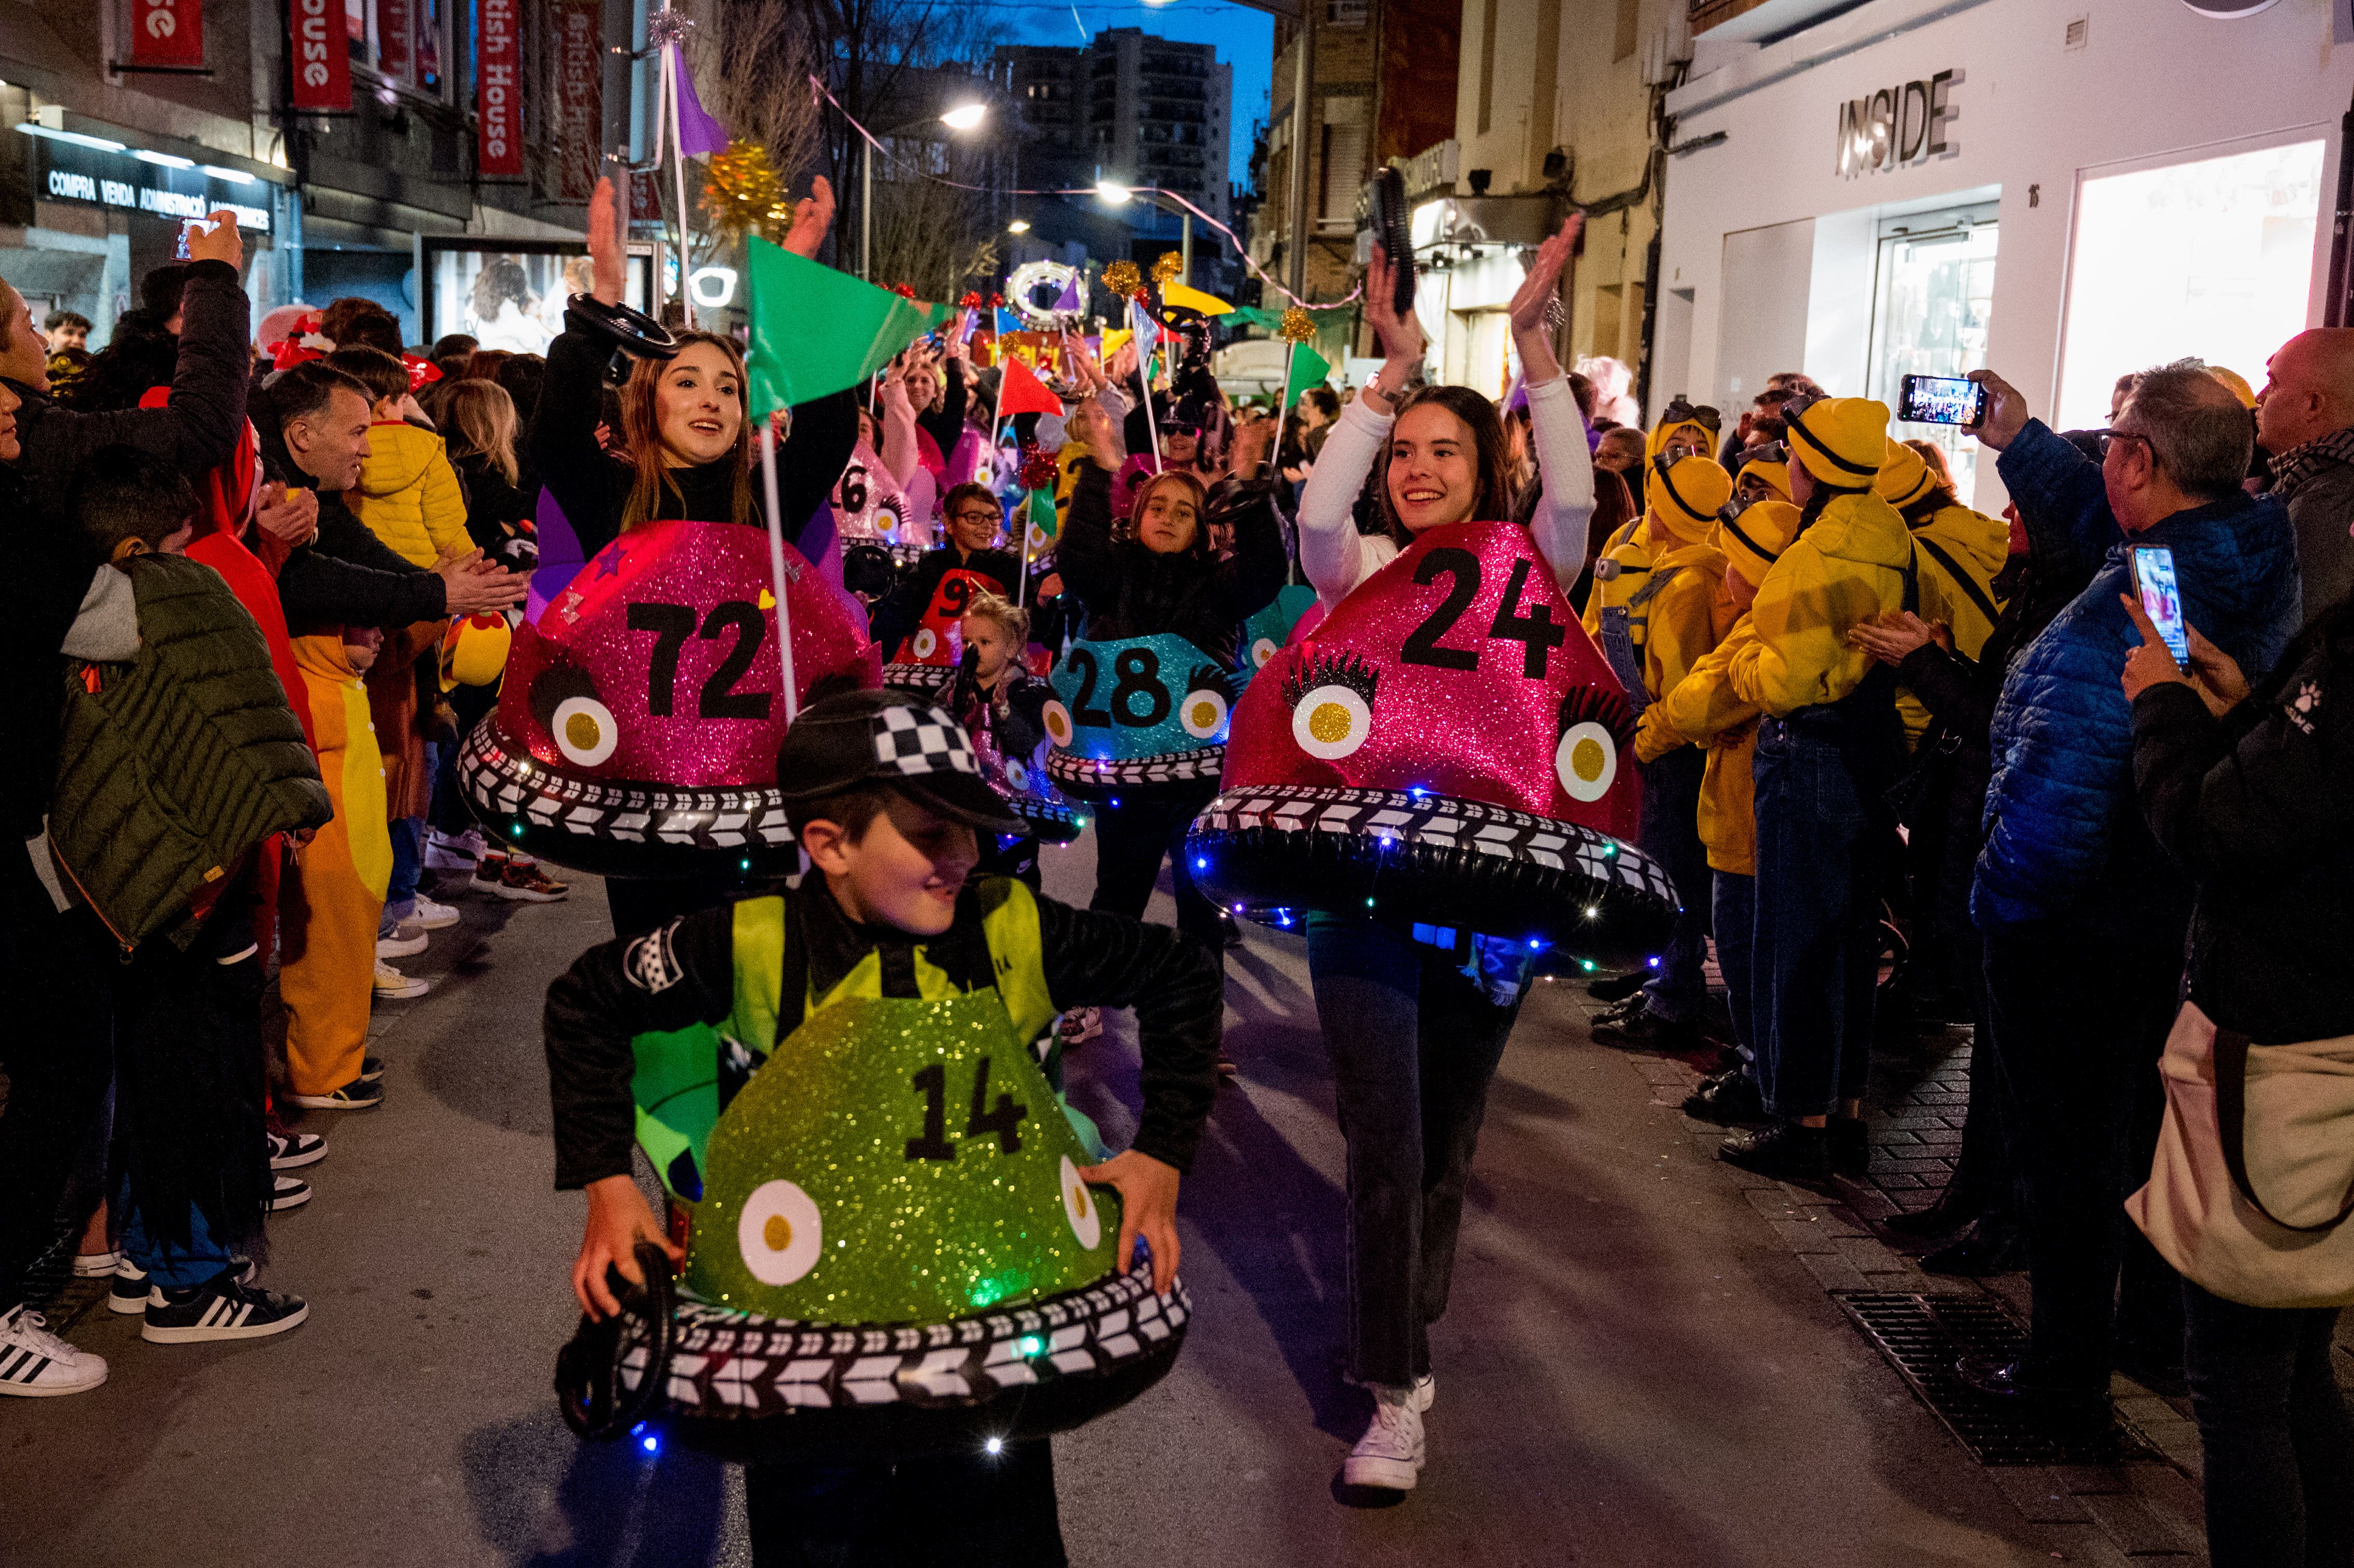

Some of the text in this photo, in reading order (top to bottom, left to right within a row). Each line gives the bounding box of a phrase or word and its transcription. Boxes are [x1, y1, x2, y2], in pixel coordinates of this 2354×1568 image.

[302, 0, 329, 87] ouse
[486, 64, 512, 158] House
[1835, 68, 1965, 180] INSIDE
[48, 170, 97, 201] COMPRA
[100, 179, 136, 208] VENDA
[139, 187, 206, 218] ADMINISTRACIÓ
[938, 577, 970, 618] 9
[1401, 547, 1565, 680] 24
[626, 600, 773, 719] 72
[1067, 647, 1172, 728] 28
[905, 1056, 1028, 1162] 14
